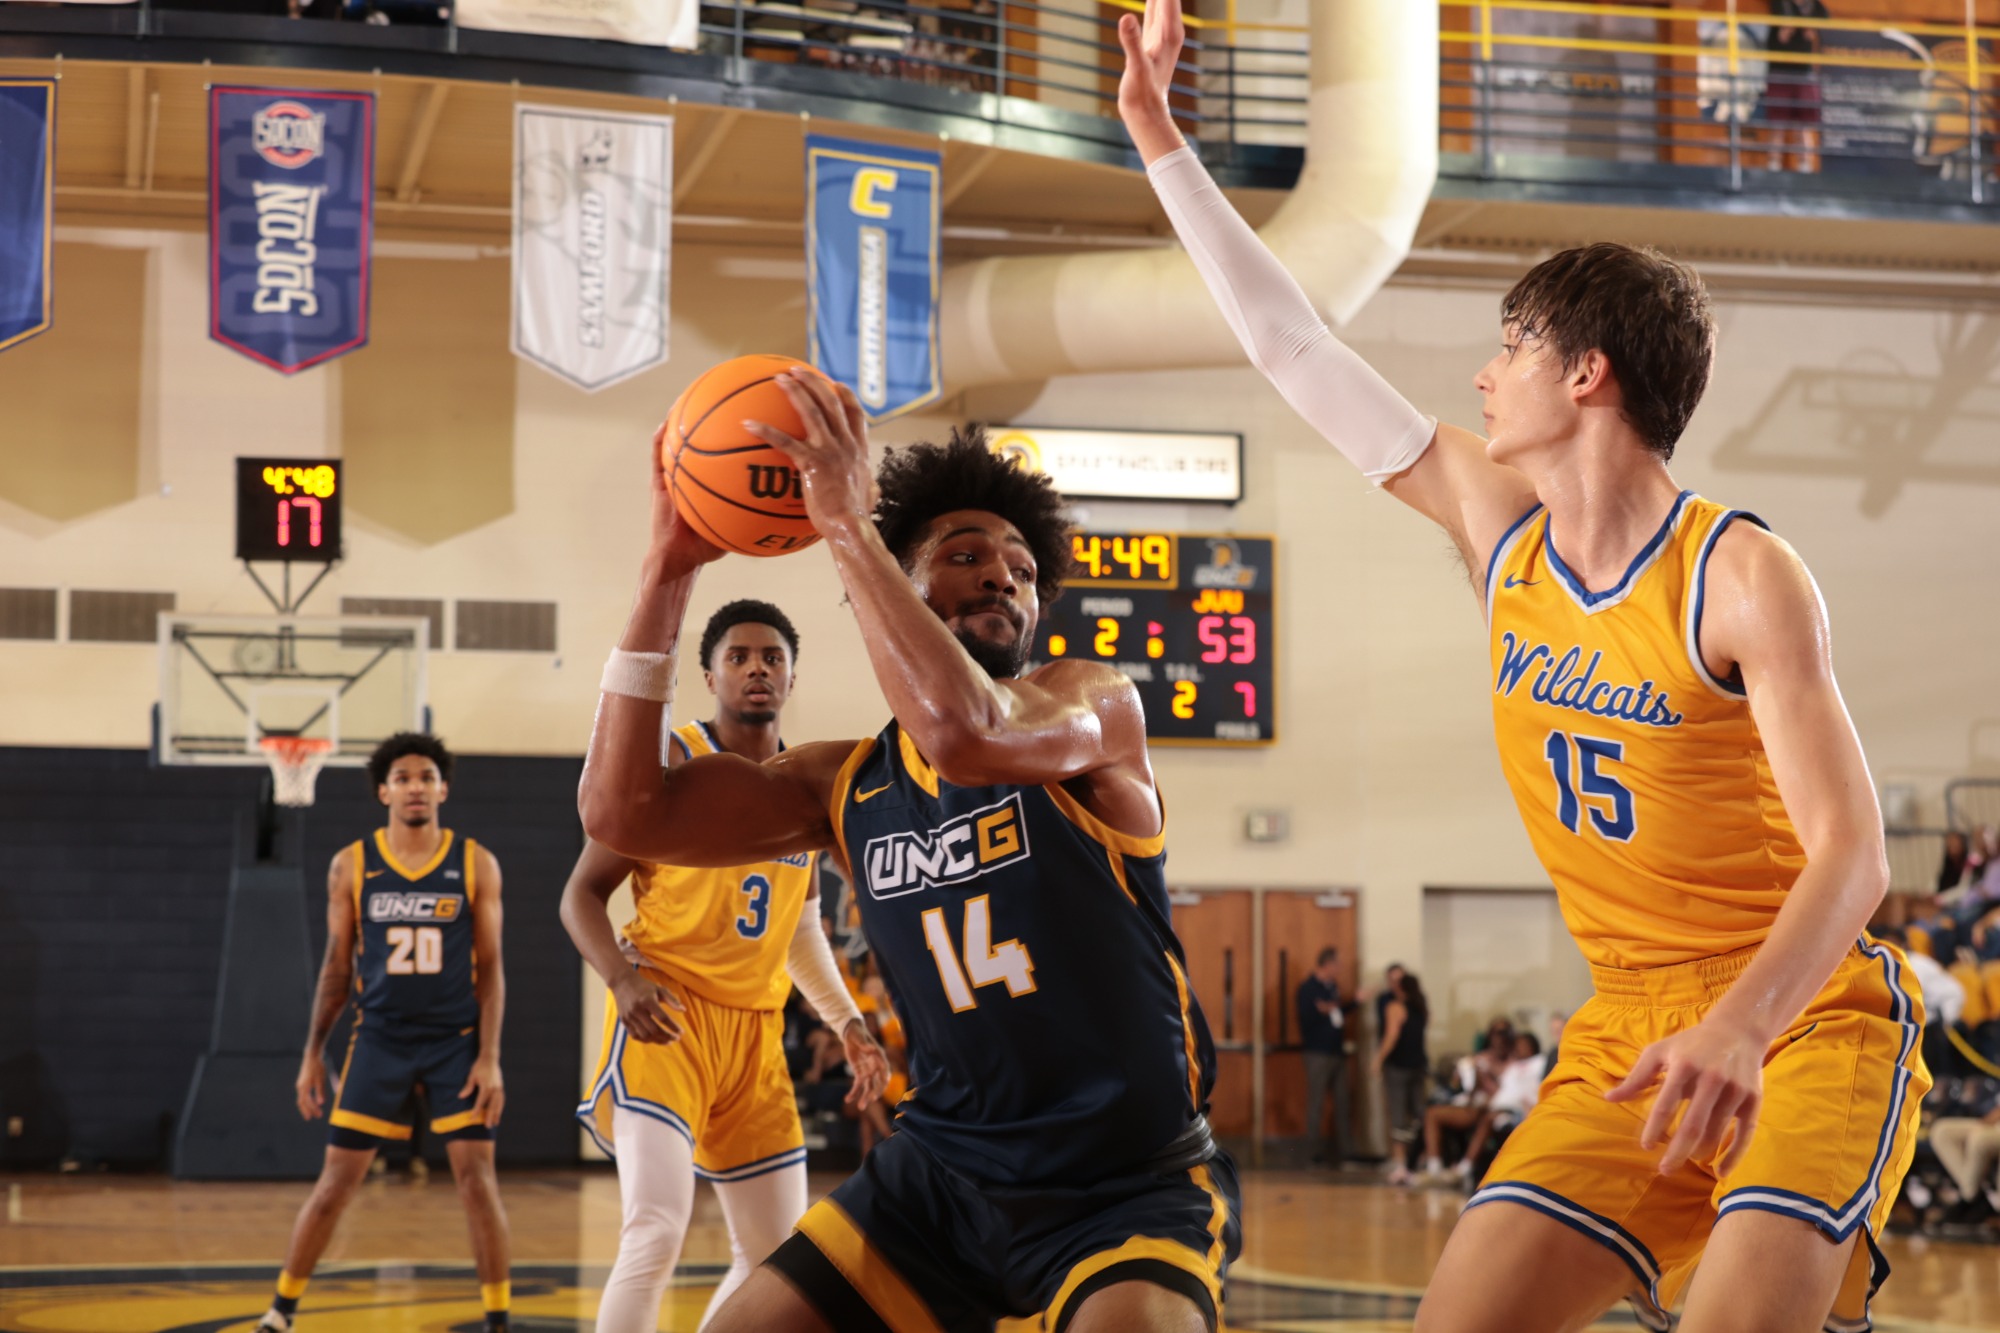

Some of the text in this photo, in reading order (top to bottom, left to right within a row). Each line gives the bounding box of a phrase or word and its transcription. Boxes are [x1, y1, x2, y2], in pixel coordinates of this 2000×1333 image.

[850, 168, 898, 218] C
[252, 181, 318, 316] SOCON
[263, 465, 335, 497] 4:48
[278, 497, 321, 546] 17
[1073, 536, 1170, 579] 4:49
[1094, 618, 1119, 656] 2
[1198, 616, 1255, 664] 53
[1172, 680, 1197, 718] 2
[1234, 681, 1256, 717] 7
[1496, 632, 1682, 726] Wildcats
[1544, 728, 1638, 844] 15
[866, 798, 1027, 896] UNCG
[369, 893, 462, 921] UNCG
[735, 873, 770, 940] 3
[386, 926, 442, 974] 20
[921, 893, 1038, 1014] 14
